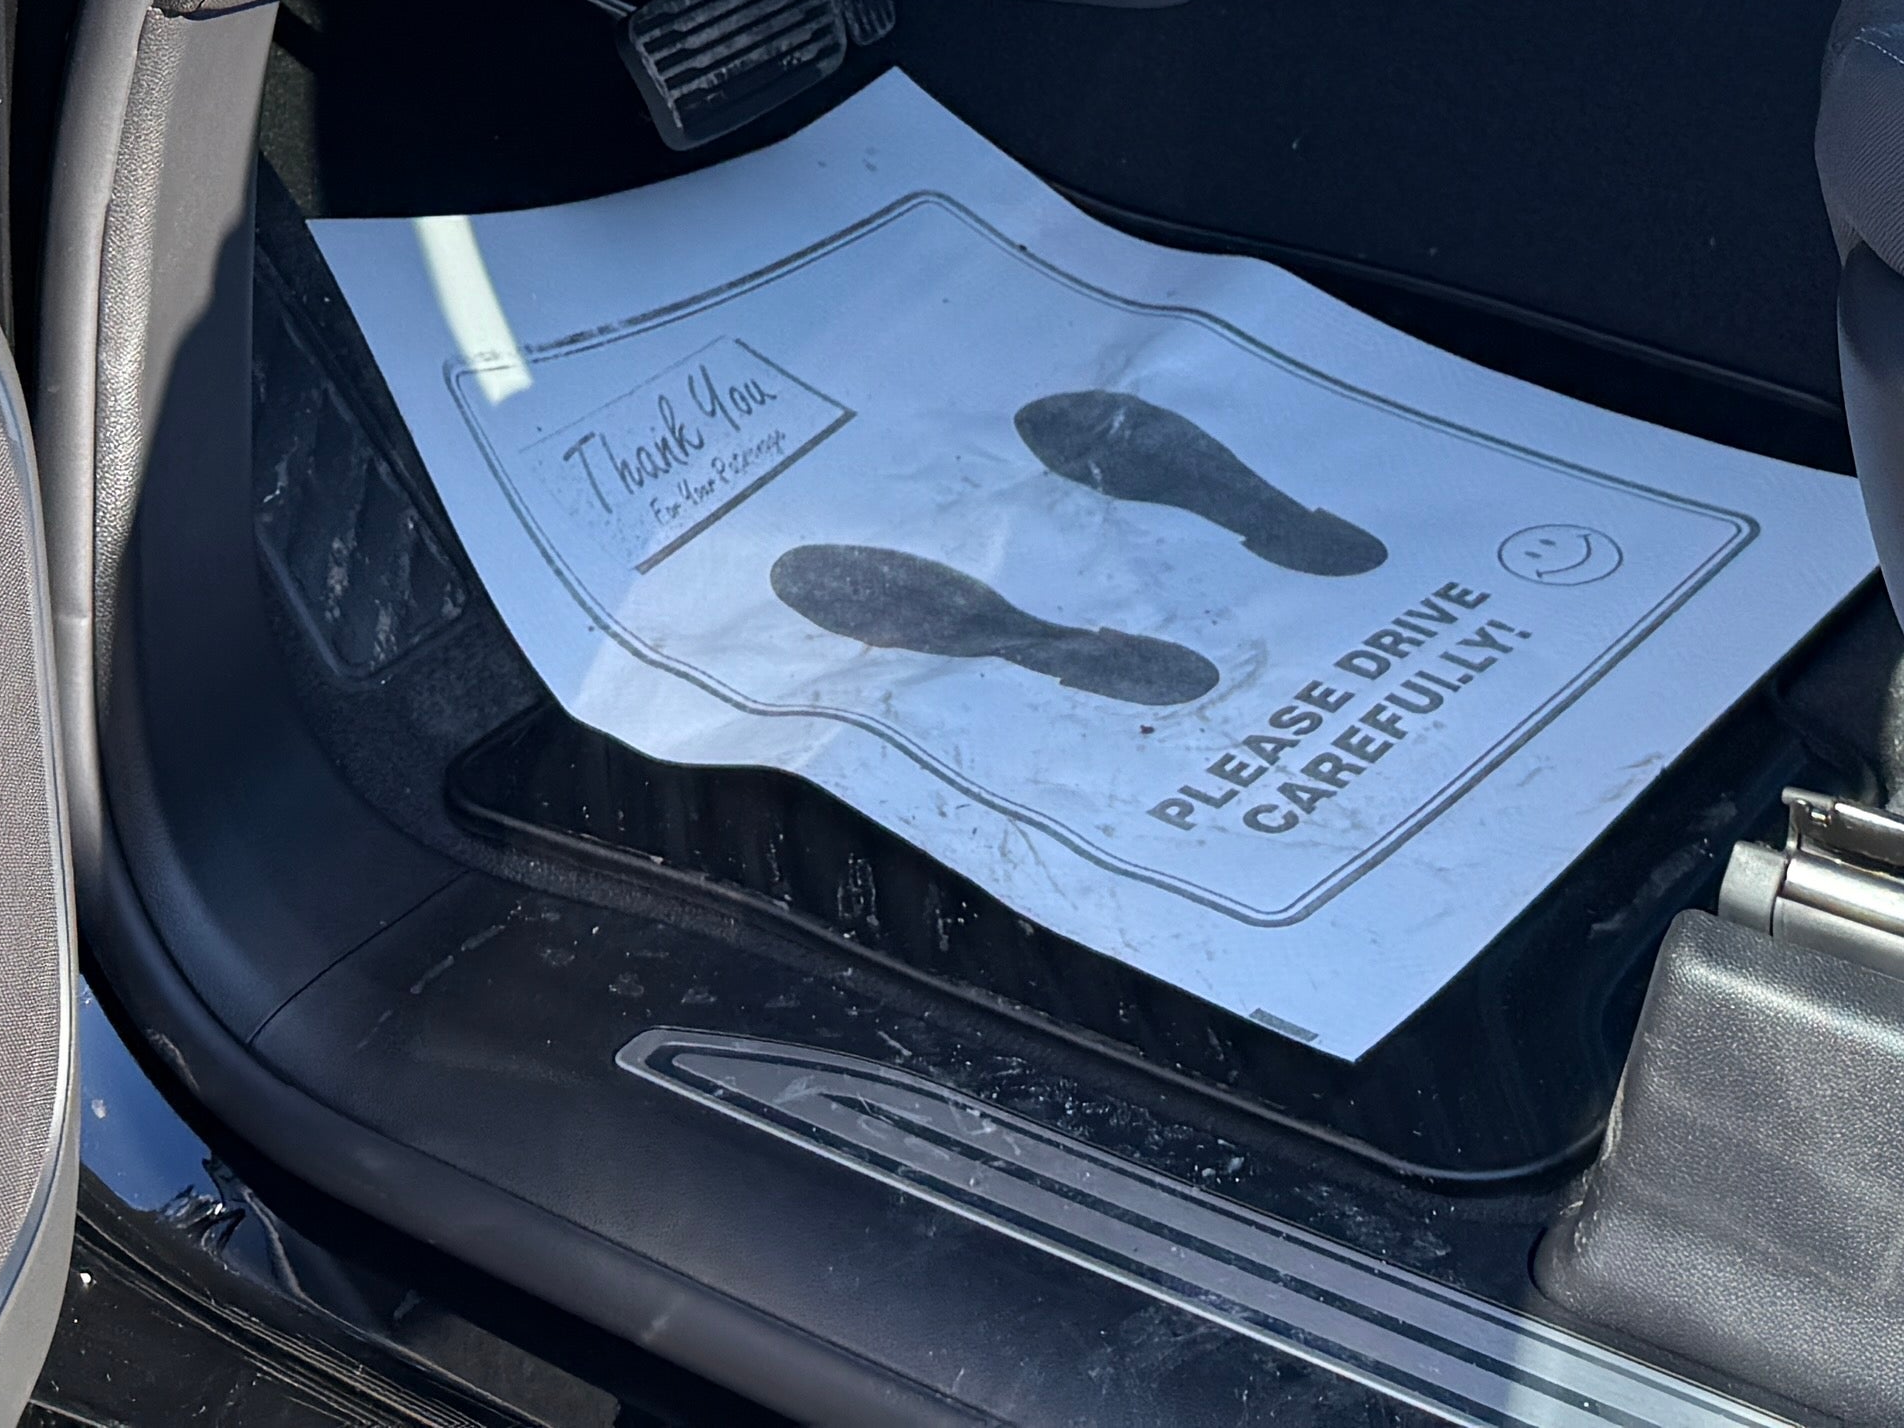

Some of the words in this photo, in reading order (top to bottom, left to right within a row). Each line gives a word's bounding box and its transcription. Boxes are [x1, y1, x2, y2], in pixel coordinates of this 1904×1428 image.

[563, 394, 705, 514] Thank
[688, 364, 778, 432] You
[1146, 679, 1356, 832] PLEASE
[1333, 580, 1492, 681] DRIVE
[1242, 618, 1533, 835] CAREFULLY!
